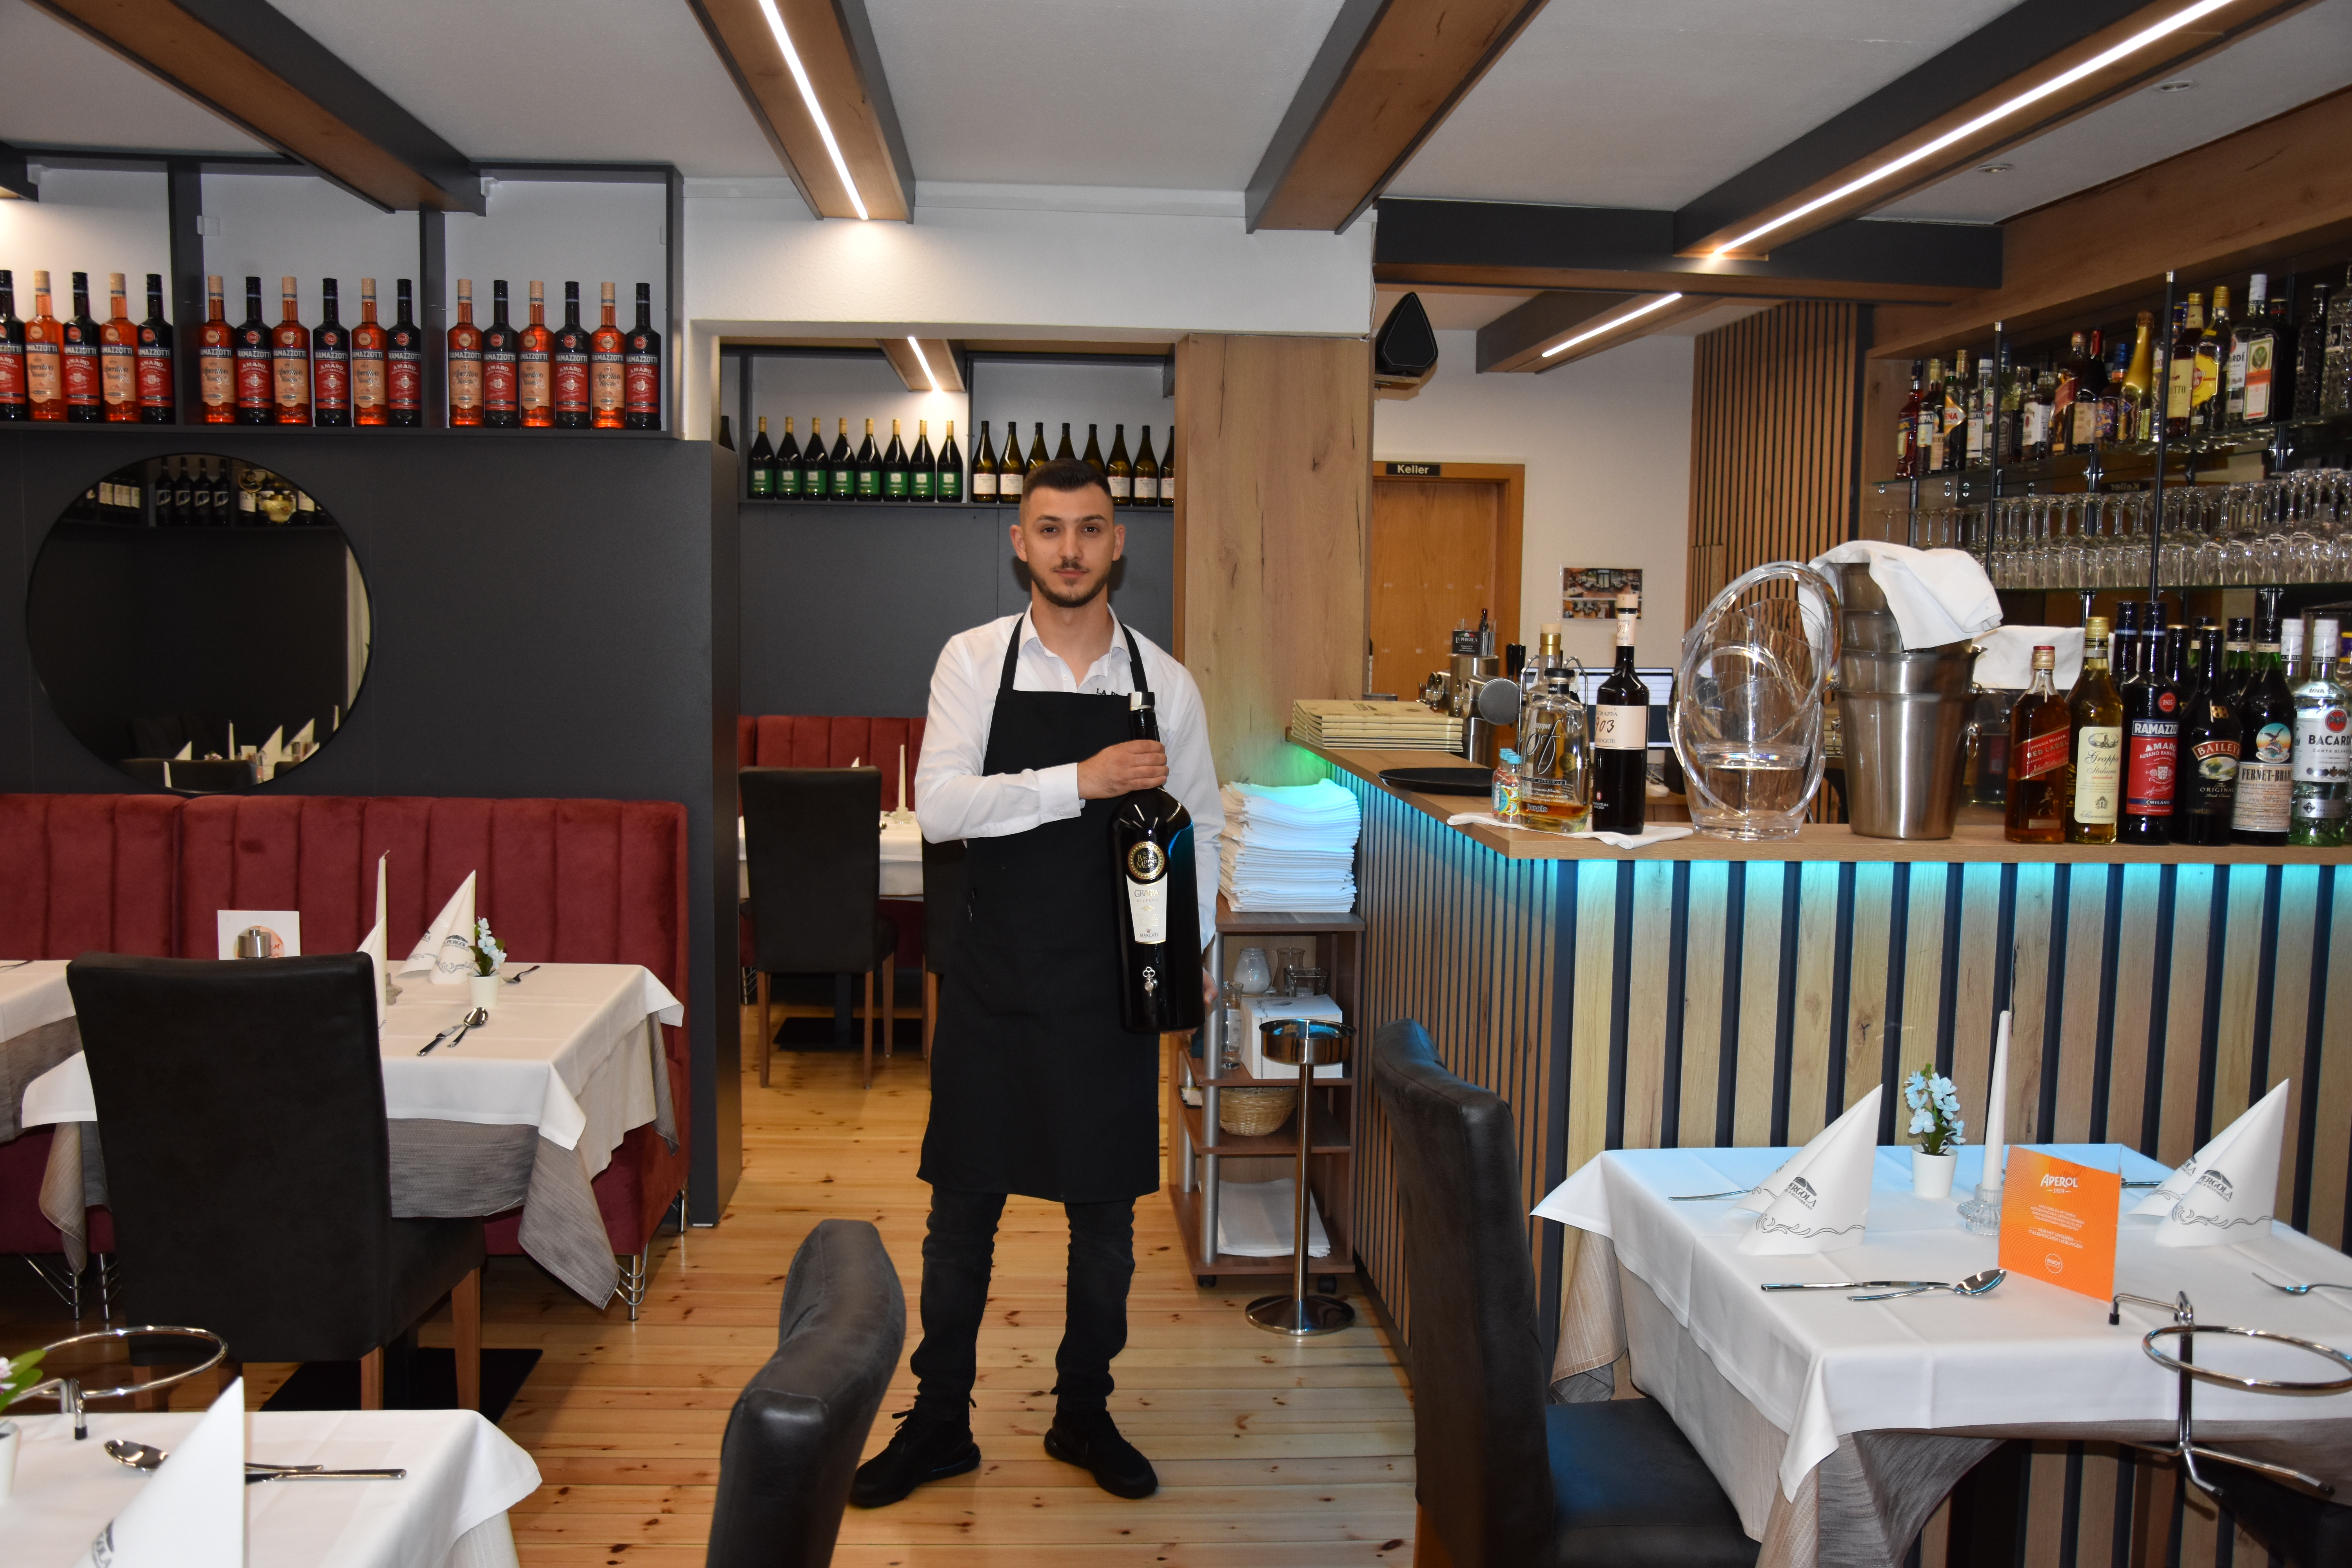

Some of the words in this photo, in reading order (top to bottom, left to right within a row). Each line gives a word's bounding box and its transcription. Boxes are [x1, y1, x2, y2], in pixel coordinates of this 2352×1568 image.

[1397, 465, 1429, 474] Keller
[2134, 723, 2178, 734] RAMAZZO
[2030, 741, 2049, 750] JOHNNIE
[2308, 735, 2351, 746] BACARD
[2027, 749, 2043, 759] RED
[2045, 740, 2069, 752] LABEL
[2145, 743, 2176, 752] AMARO
[2198, 743, 2240, 756] BAILEYS
[2084, 750, 2118, 766] Grappa
[2087, 763, 2116, 774] Italiana
[2242, 768, 2292, 782] FERNET-BRAN
[1527, 804, 1548, 813] Bonollo
[1134, 889, 1159, 898] GRAPPA
[2040, 1174, 2078, 1188] APEROL
[2207, 1185, 2229, 1202] RESTAURANT
[1791, 1192, 1813, 1210] RESTAURANT
[2029, 1229, 2058, 1241] ITALIENISCHEN
[2058, 1238, 2082, 1249] LIEBLINGEN
[2055, 1232, 2073, 1241] UNSEREN
